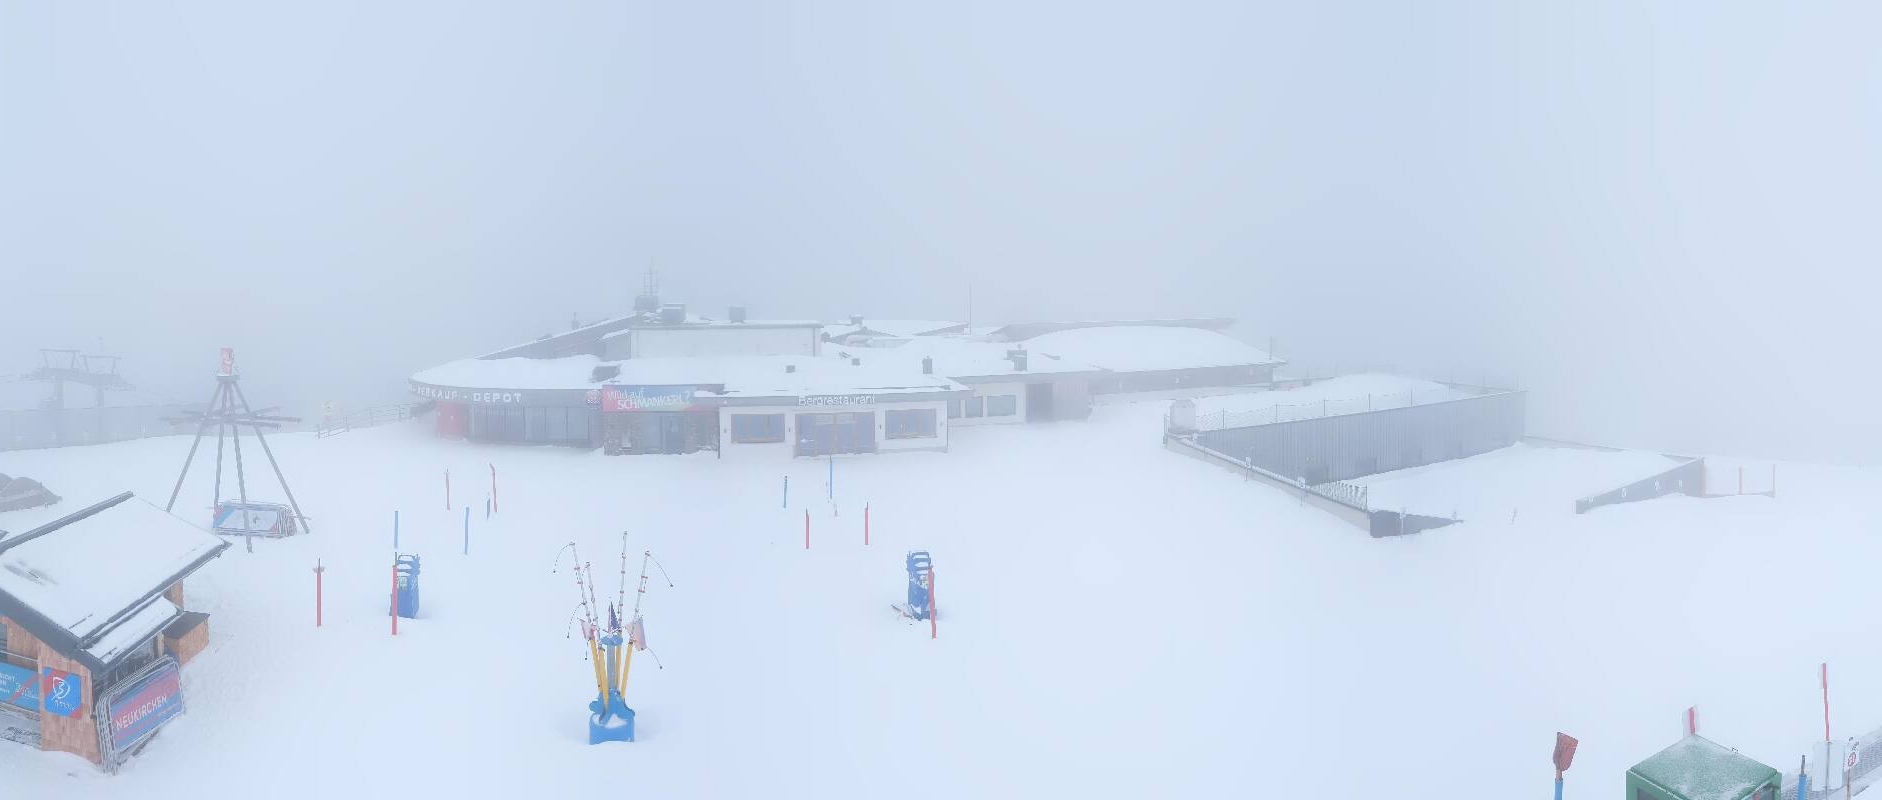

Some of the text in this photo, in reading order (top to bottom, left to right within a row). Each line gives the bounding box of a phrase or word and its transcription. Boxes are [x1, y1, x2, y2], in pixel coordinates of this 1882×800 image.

[473, 392, 522, 402] DEPOT
[798, 395, 875, 406] Bergrestaurant
[116, 695, 167, 732] NEUKIRCHEN
